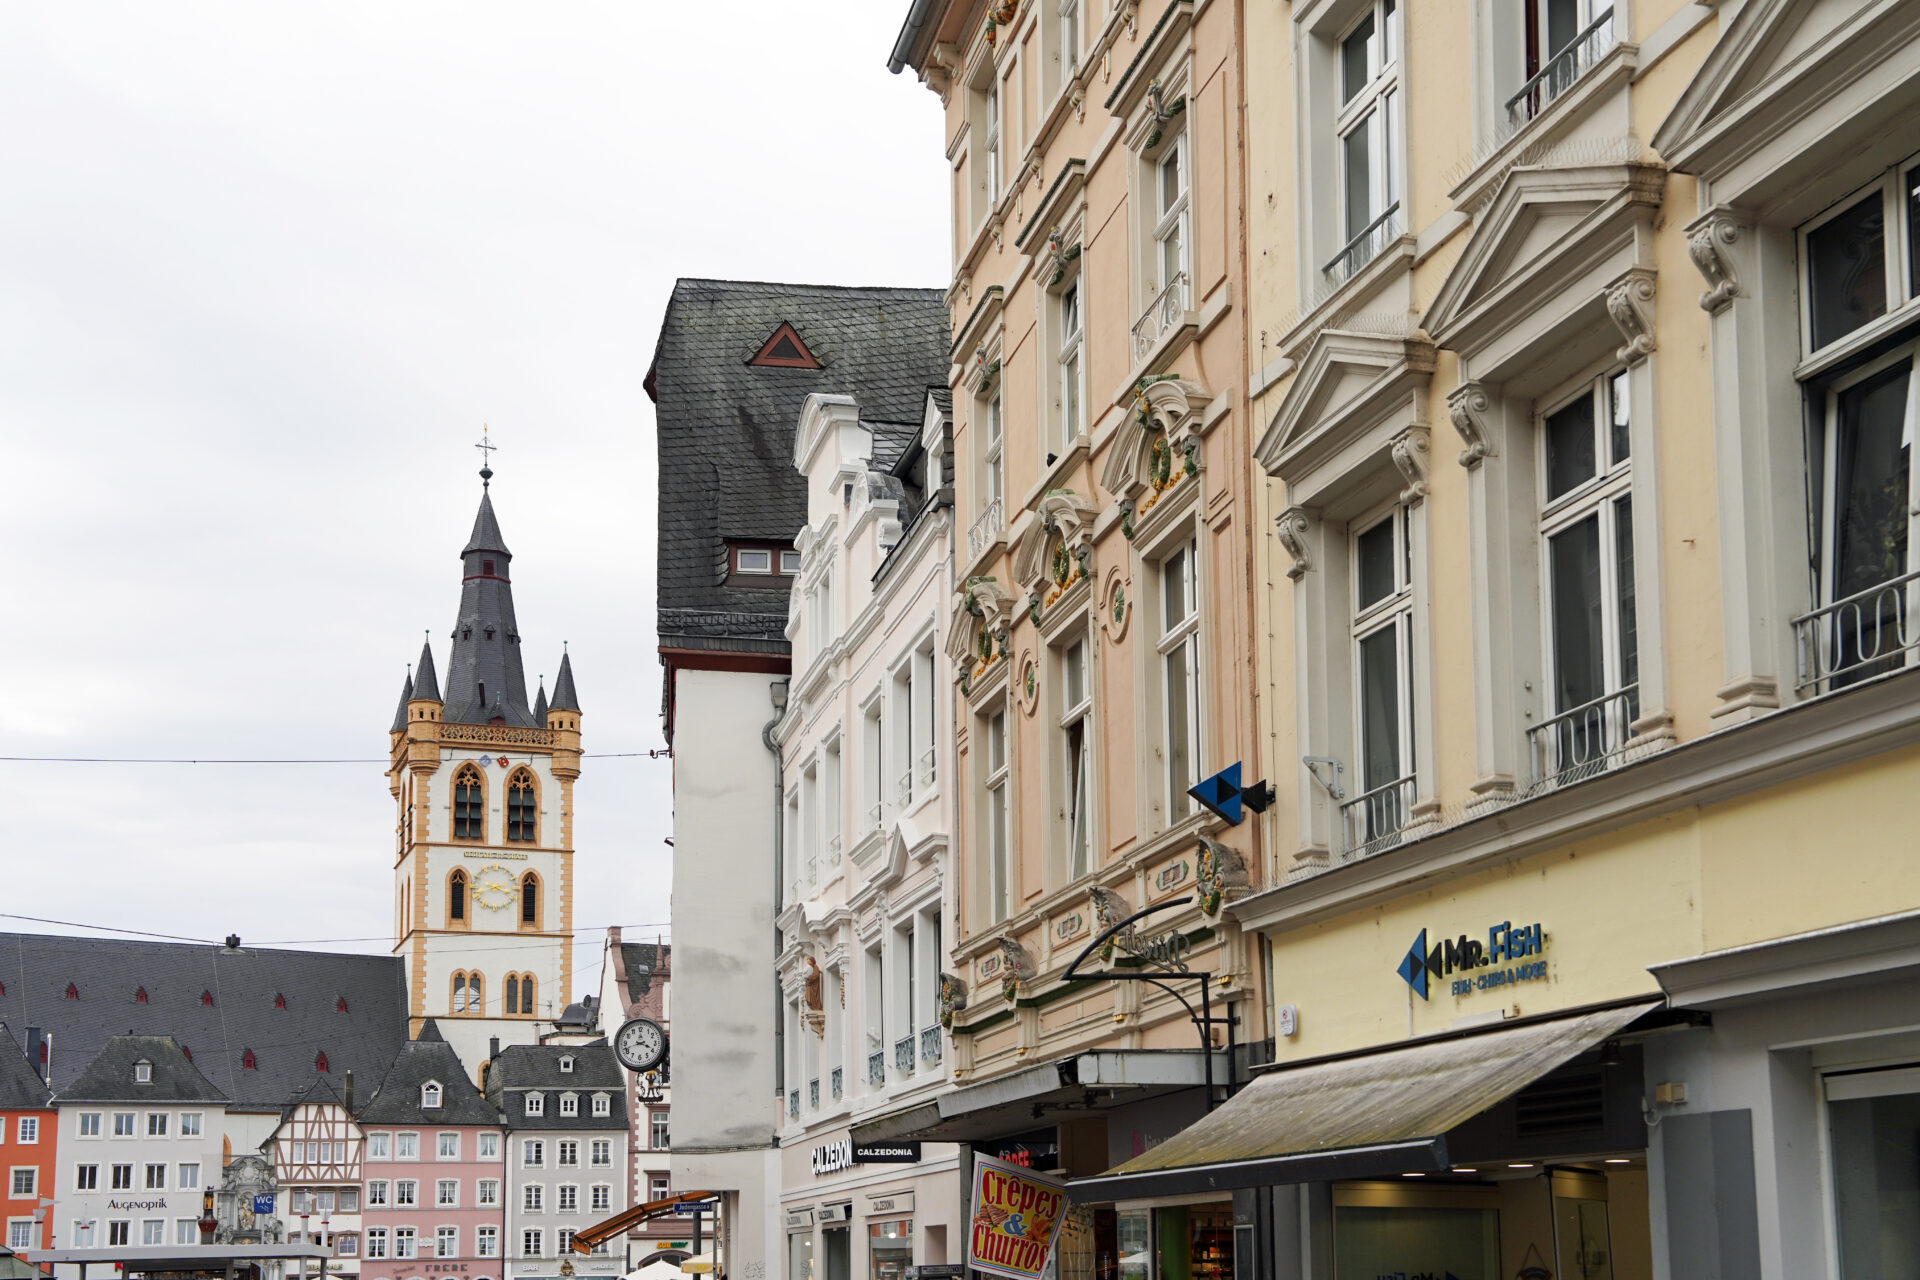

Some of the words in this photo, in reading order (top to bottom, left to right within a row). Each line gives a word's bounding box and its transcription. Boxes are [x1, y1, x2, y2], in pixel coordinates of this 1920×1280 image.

[1477, 970, 1505, 990] CHIPS
[1507, 968, 1515, 983] &
[1516, 960, 1547, 982] MORE
[857, 1148, 913, 1156] CALZEDONIA
[255, 1196, 273, 1204] WC
[982, 1170, 1062, 1218] Crêpes
[873, 1200, 895, 1212] CALZEDONIA
[1003, 1213, 1028, 1236] &
[655, 1241, 688, 1249] SUBWAY
[972, 1223, 1050, 1271] Churros
